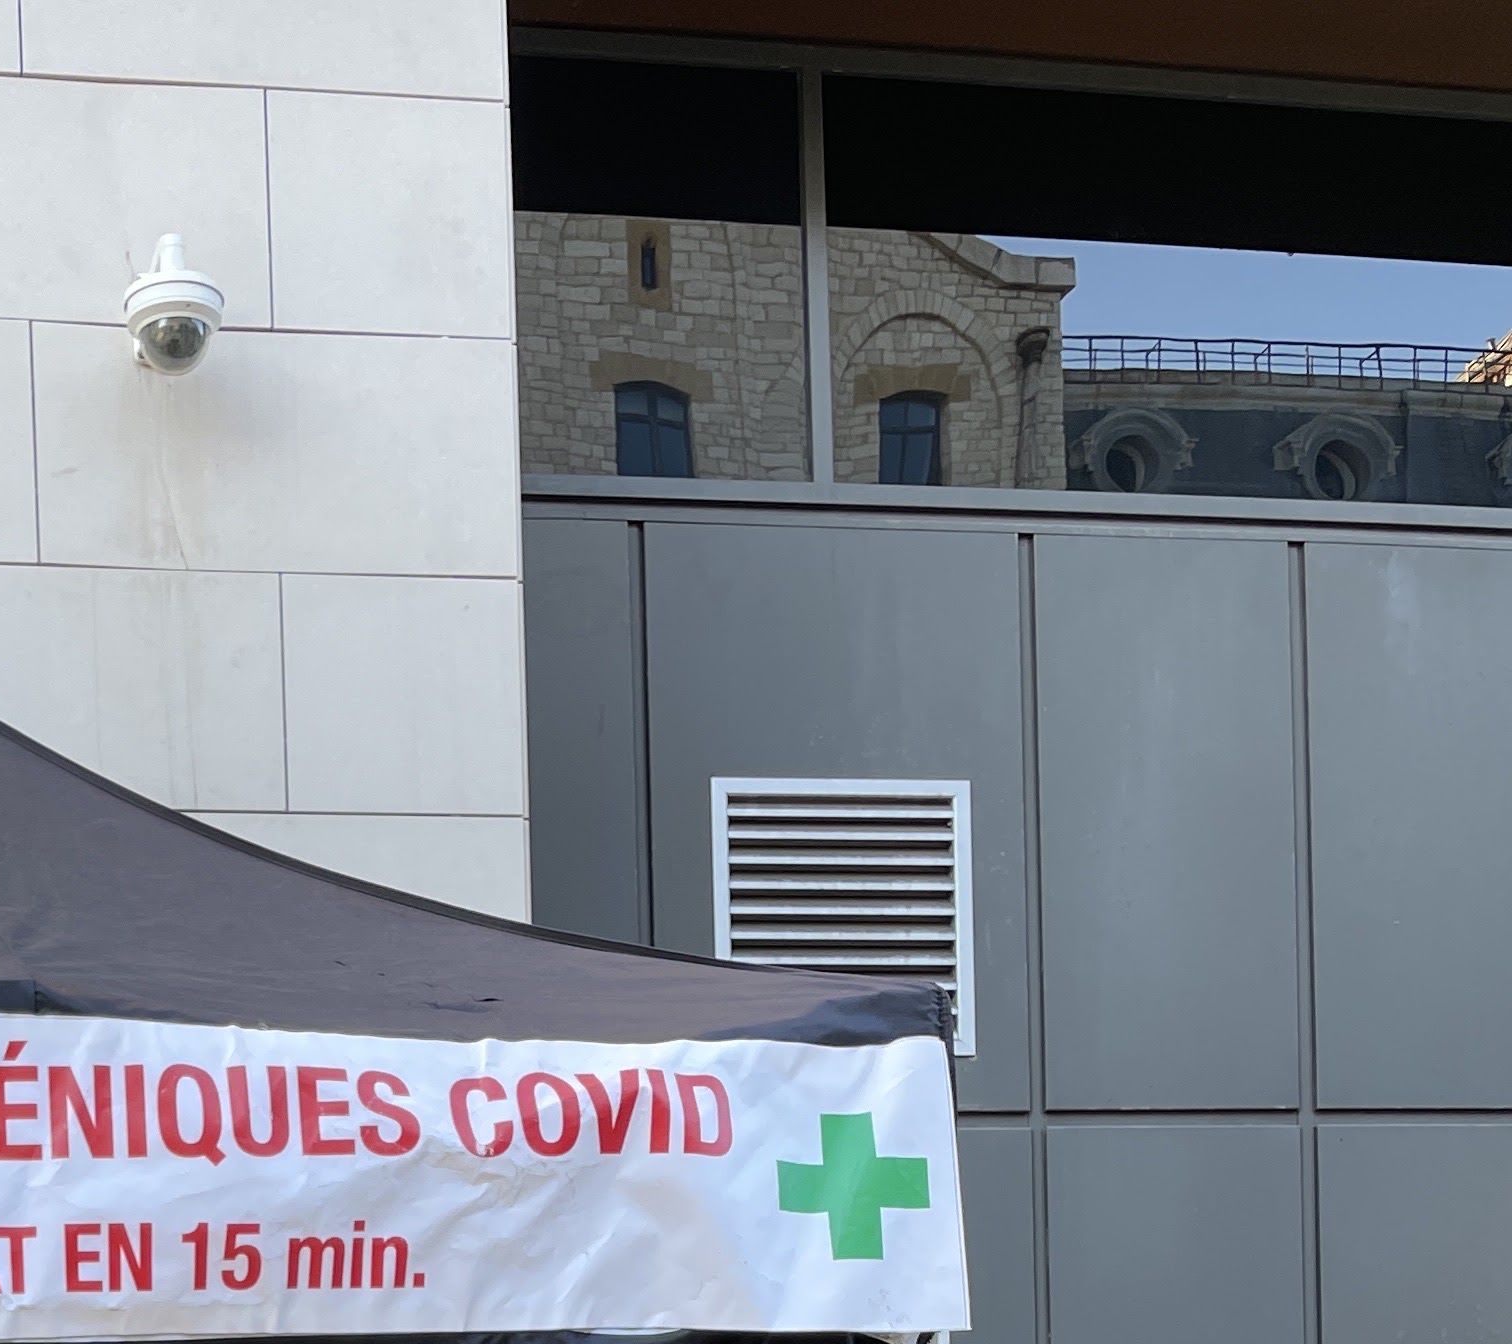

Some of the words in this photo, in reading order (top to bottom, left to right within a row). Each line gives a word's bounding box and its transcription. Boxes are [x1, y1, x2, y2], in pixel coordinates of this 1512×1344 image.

[449, 1069, 734, 1157] COVID
[63, 1222, 153, 1293] EN
[180, 1222, 262, 1291] 15
[286, 1220, 426, 1290] min.
